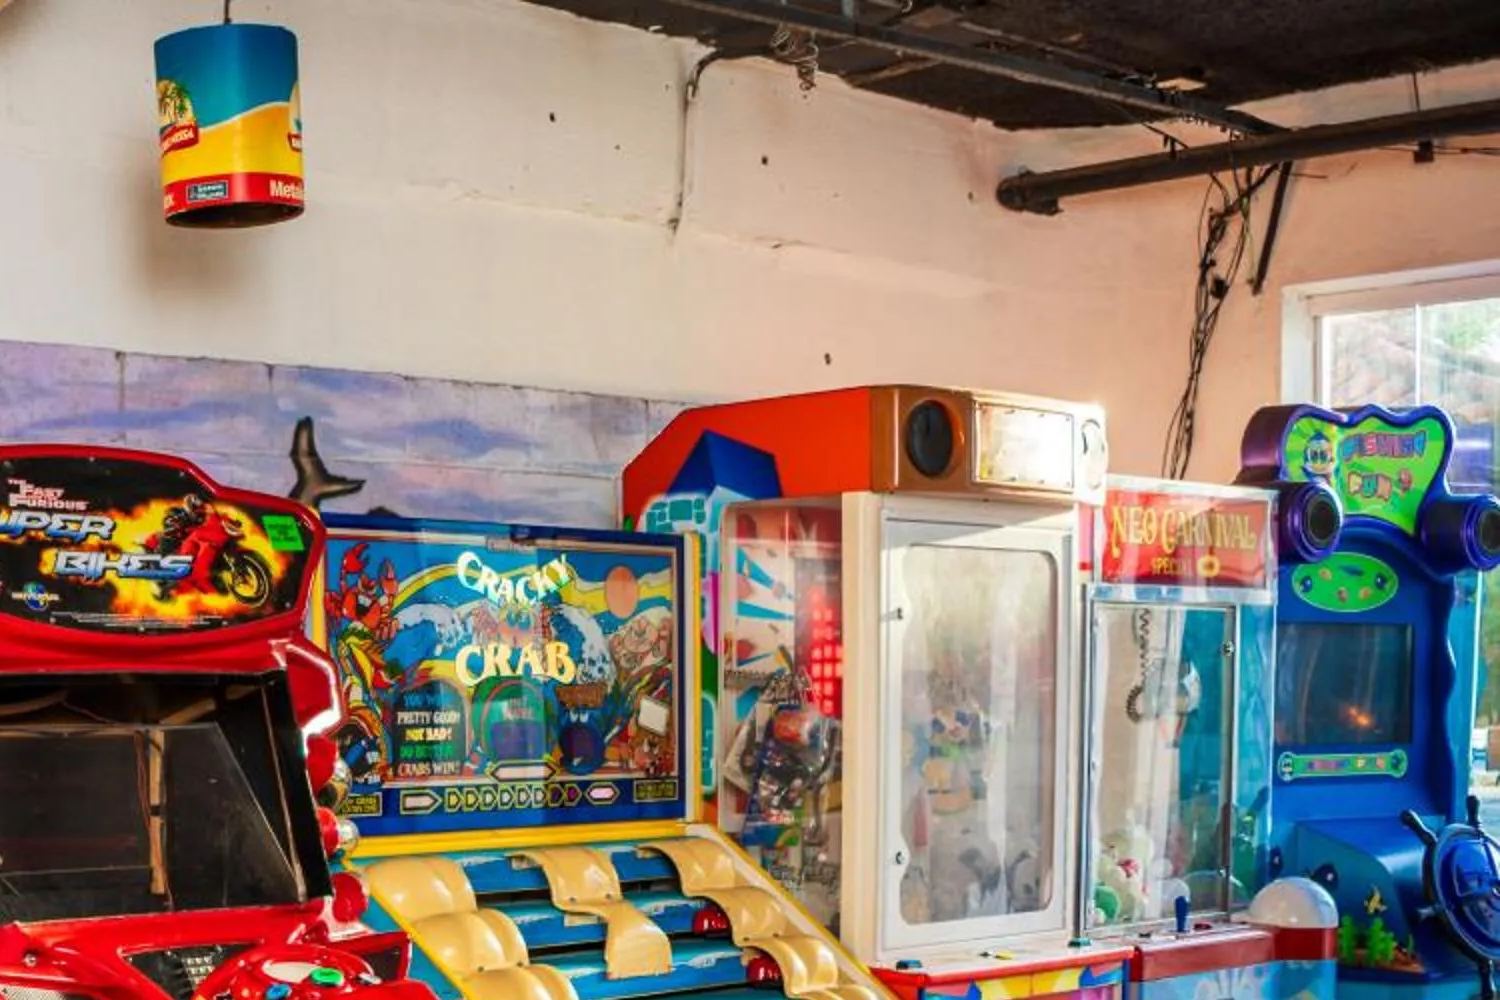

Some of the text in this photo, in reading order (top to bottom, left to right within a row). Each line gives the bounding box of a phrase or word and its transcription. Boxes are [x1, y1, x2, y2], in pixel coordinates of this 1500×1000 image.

[9, 493, 89, 510] FURIOUS
[1111, 505, 1257, 558] NEO CARNIVAL
[55, 550, 193, 581] BIKES
[455, 640, 577, 687] CRAB
